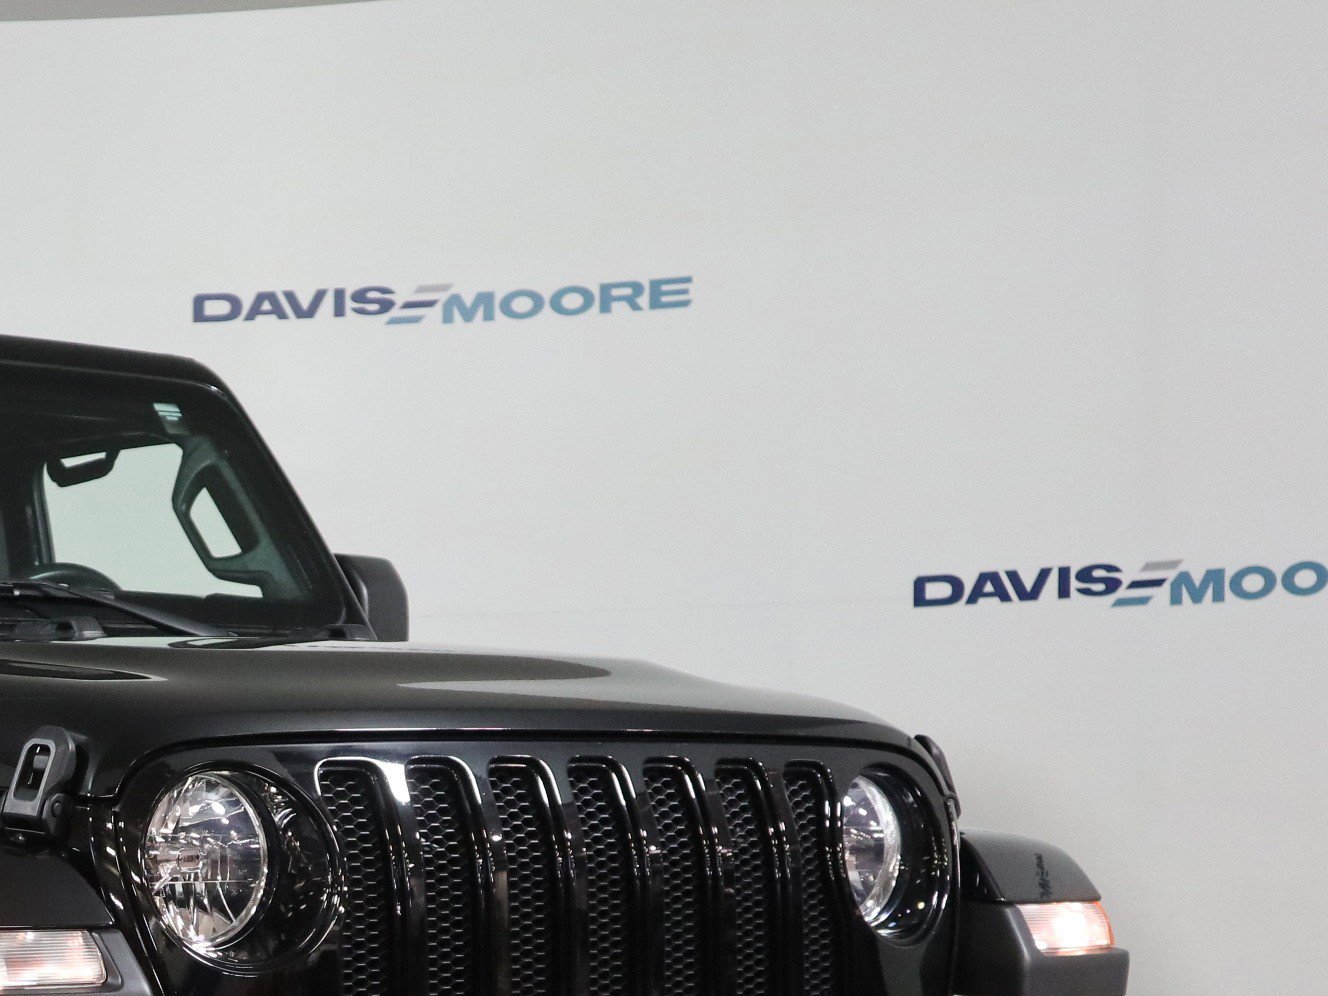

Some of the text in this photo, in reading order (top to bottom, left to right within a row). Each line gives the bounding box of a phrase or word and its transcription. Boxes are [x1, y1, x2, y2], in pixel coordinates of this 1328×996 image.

[191, 275, 694, 325] DAVIS MOORE
[913, 560, 1328, 607] DAVIS MOO
